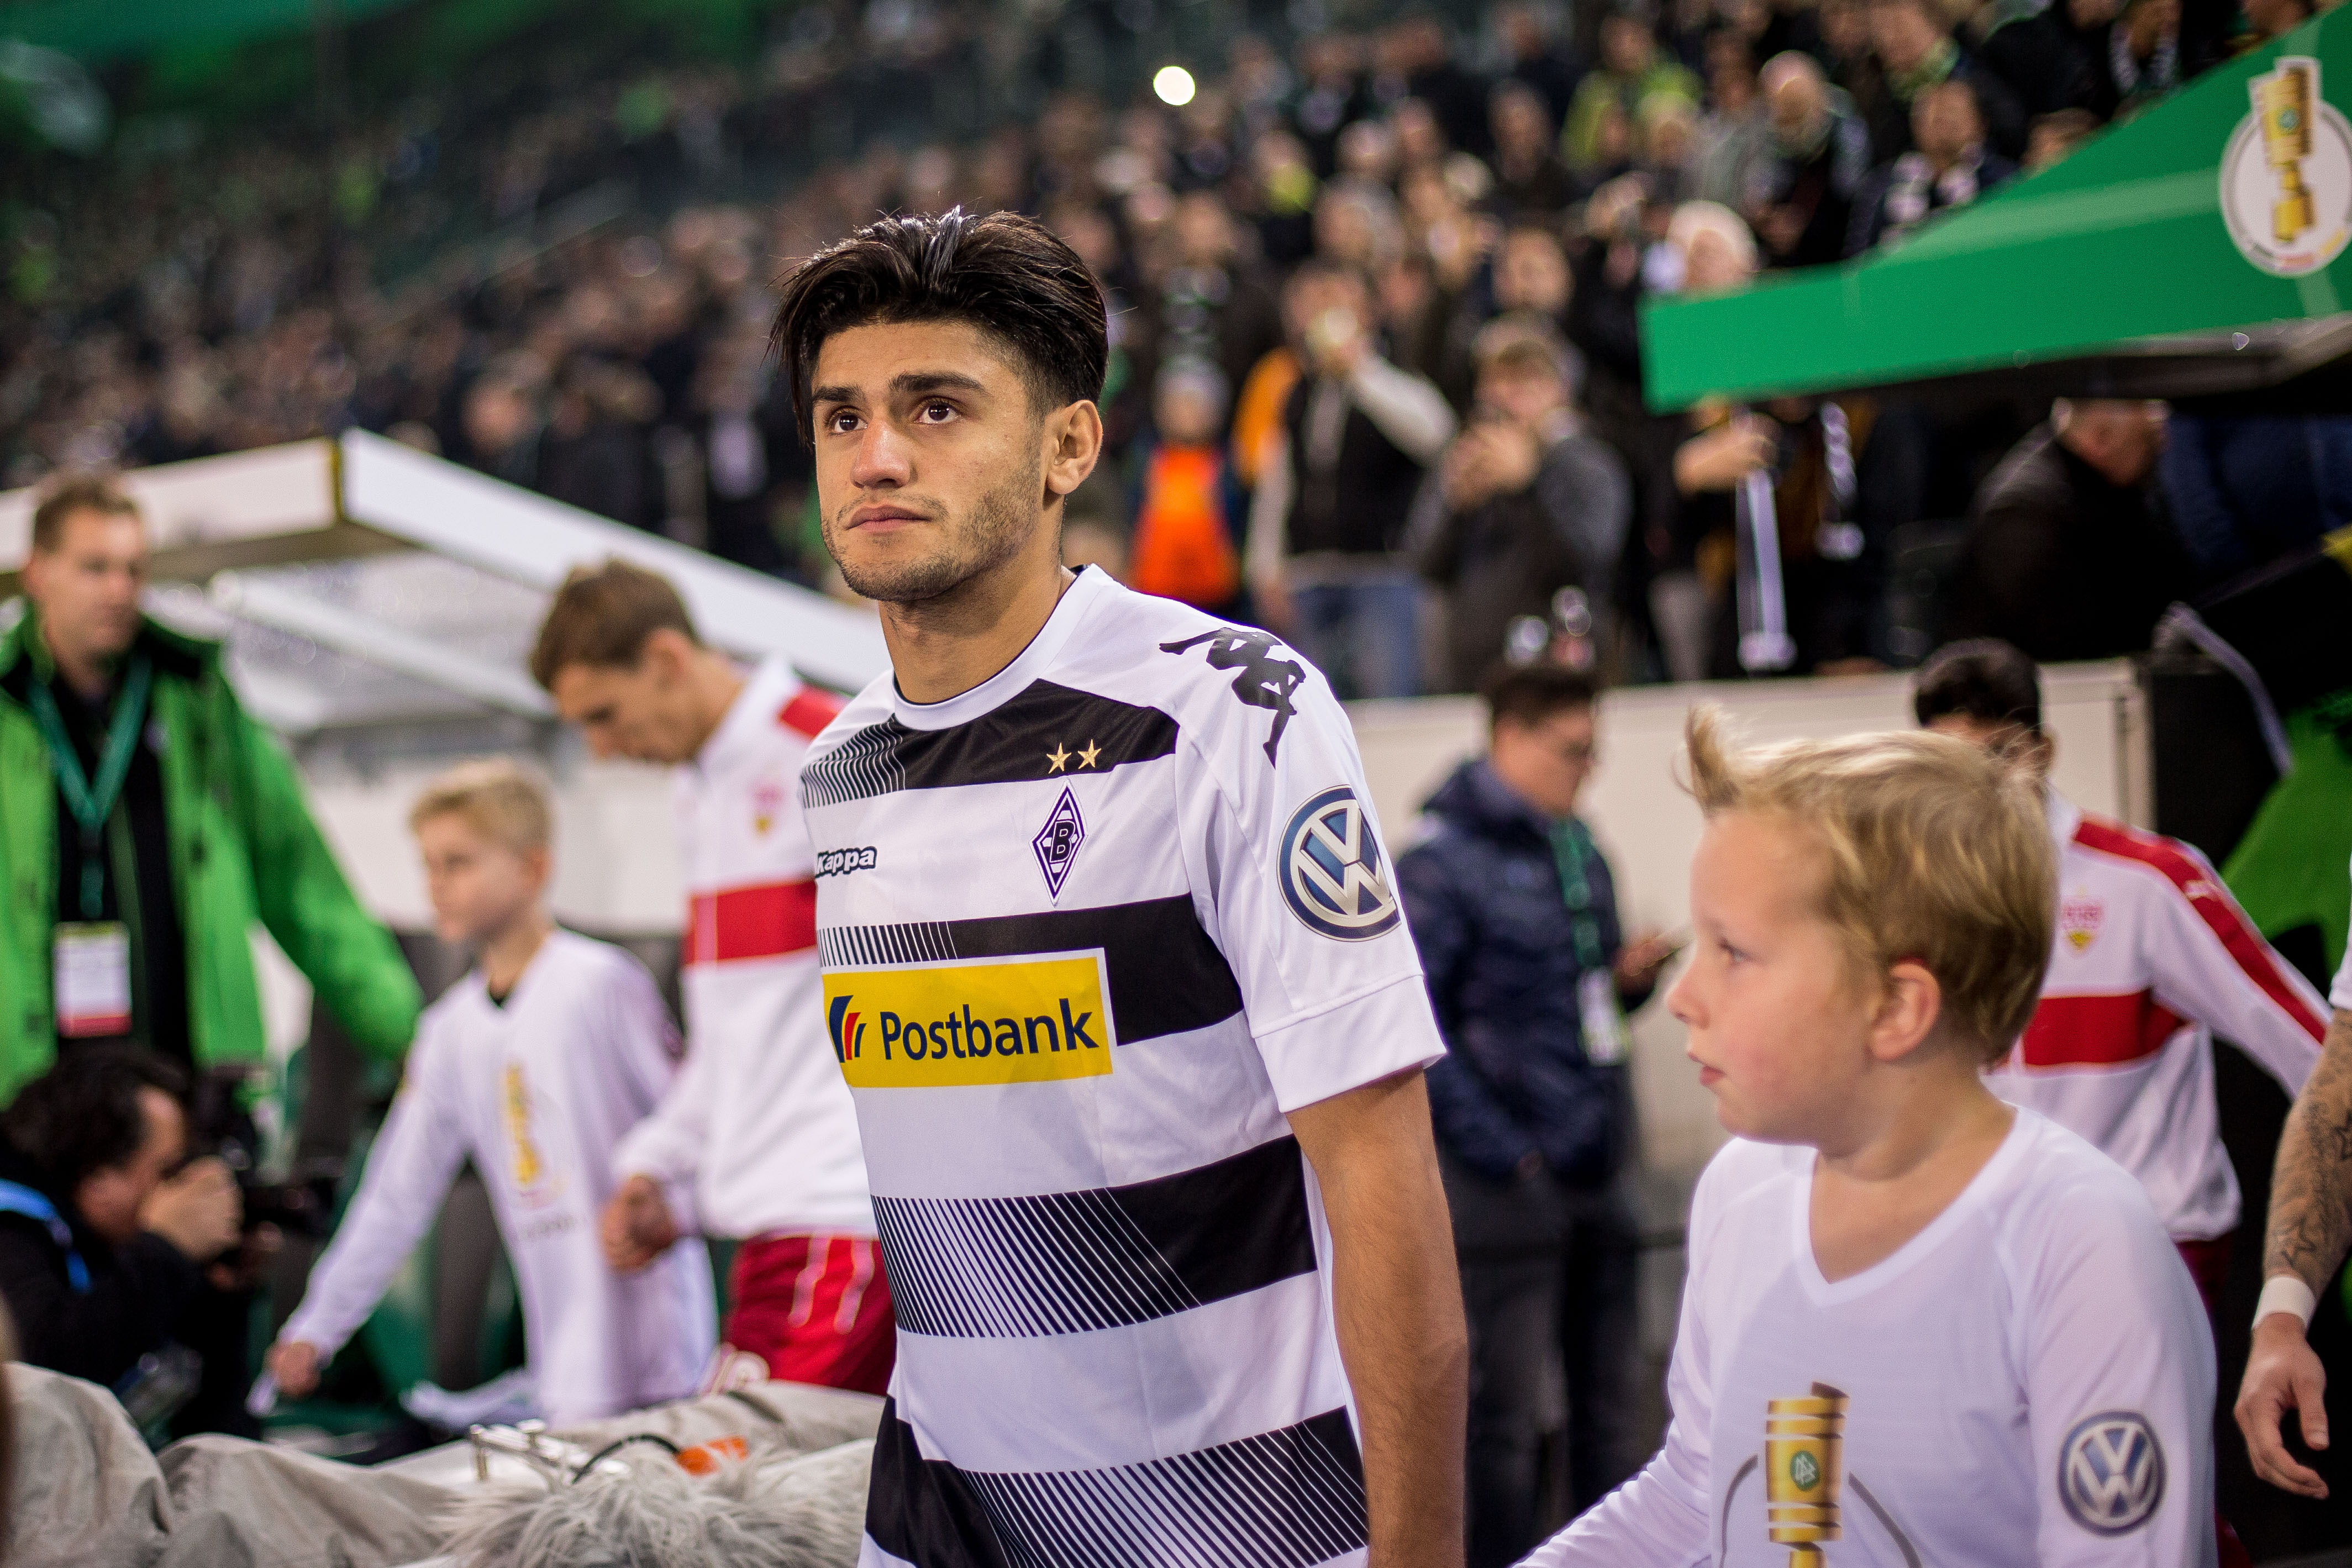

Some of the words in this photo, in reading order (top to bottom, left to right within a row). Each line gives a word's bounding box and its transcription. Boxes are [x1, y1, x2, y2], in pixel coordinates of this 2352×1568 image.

[815, 846, 877, 877] Kappa
[1050, 820, 1076, 863] B
[880, 998, 1100, 1061] Postbank
